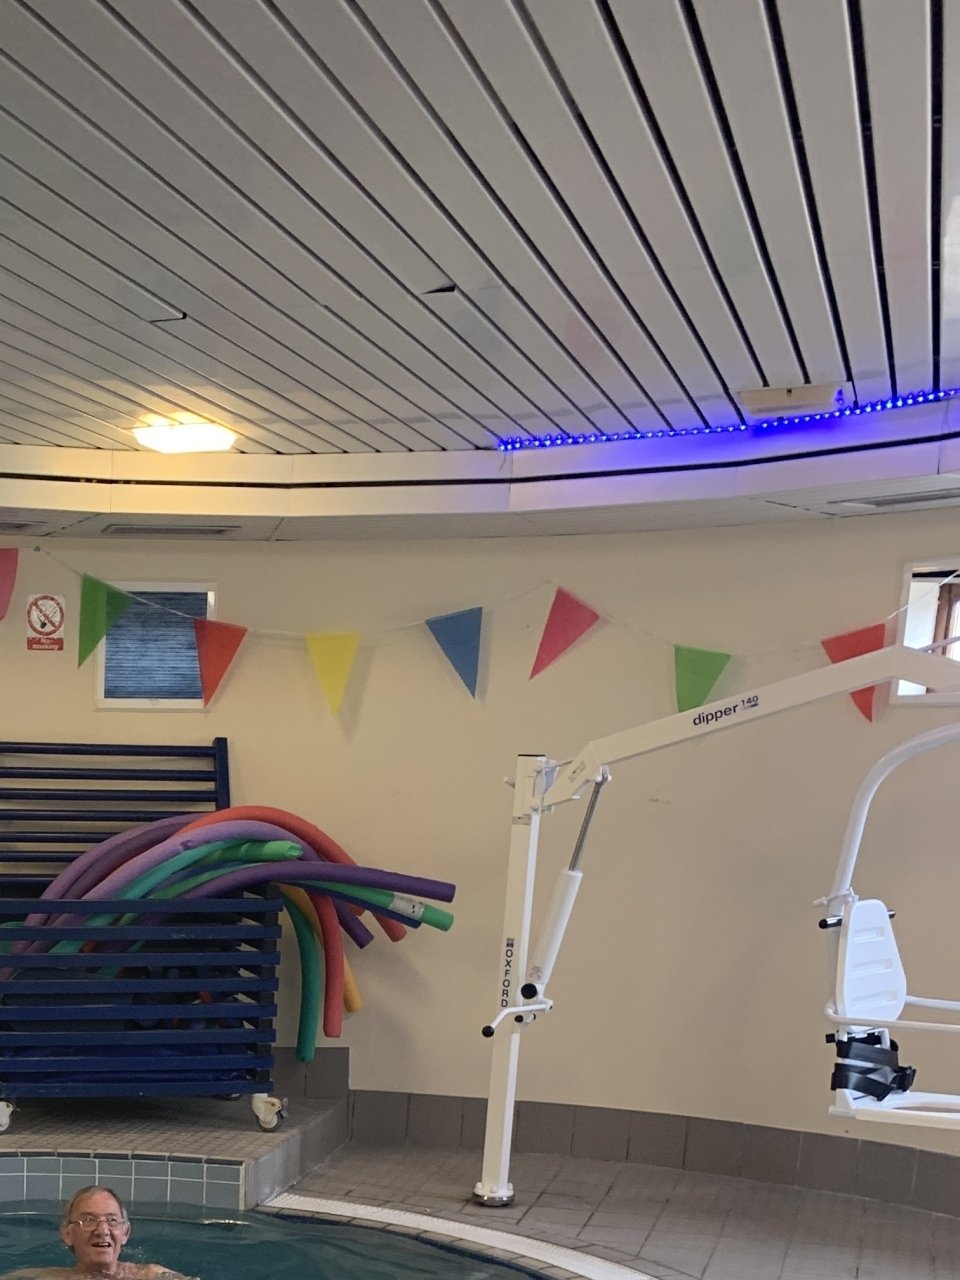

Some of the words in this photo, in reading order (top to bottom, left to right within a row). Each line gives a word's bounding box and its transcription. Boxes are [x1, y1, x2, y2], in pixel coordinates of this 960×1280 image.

[692, 704, 739, 726] dipper
[741, 695, 759, 706] 140
[501, 949, 513, 1007] OXFORD
